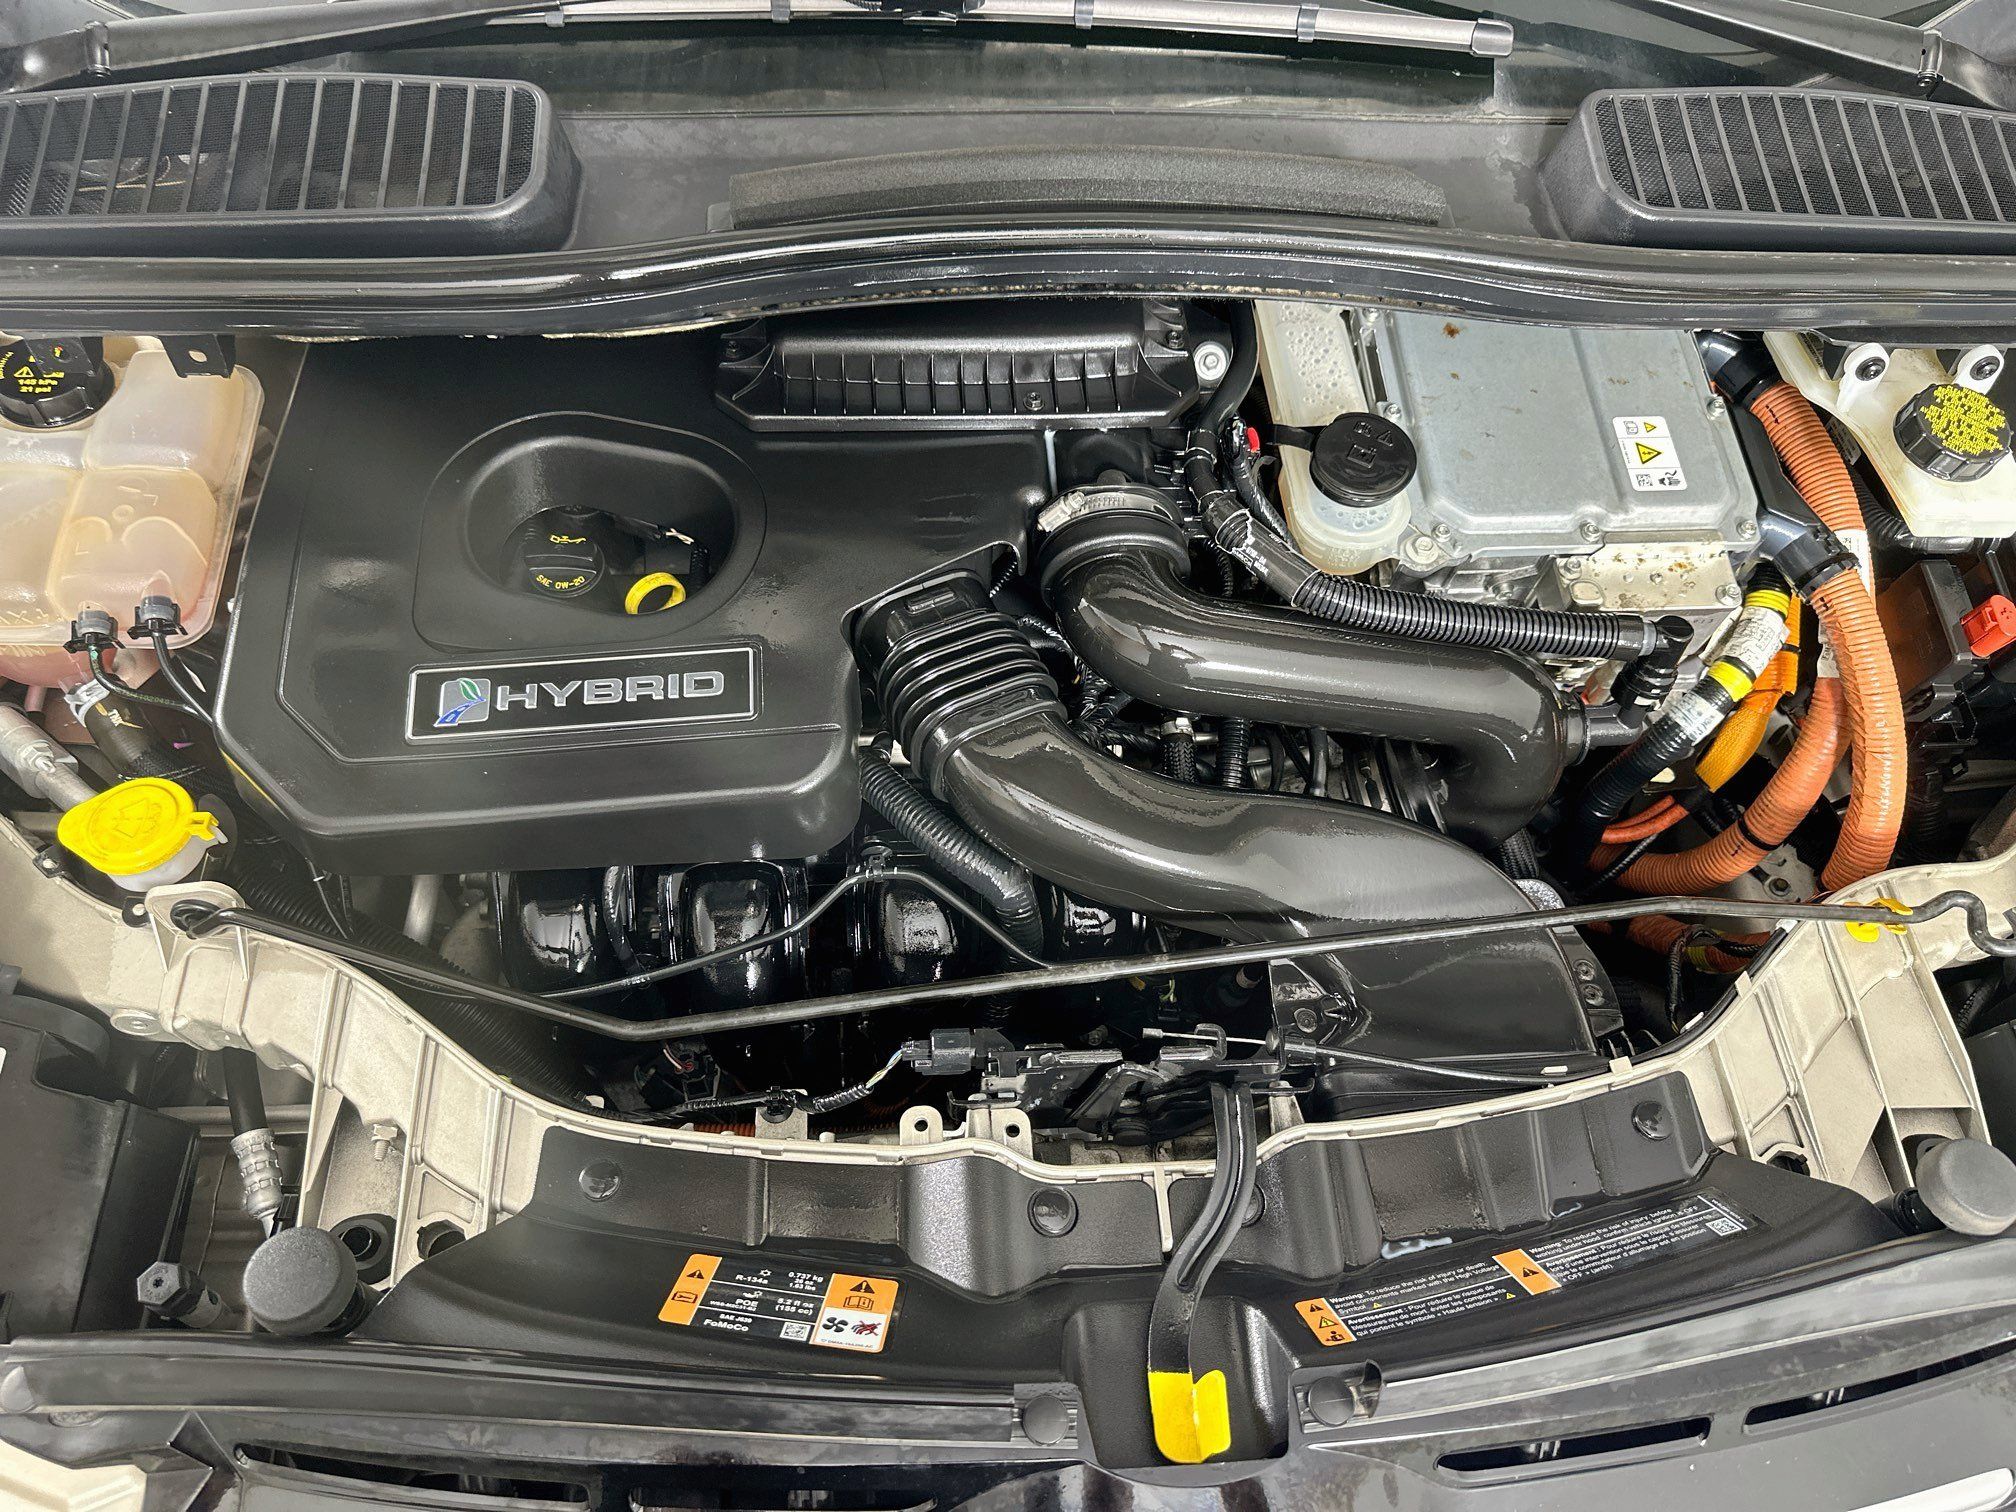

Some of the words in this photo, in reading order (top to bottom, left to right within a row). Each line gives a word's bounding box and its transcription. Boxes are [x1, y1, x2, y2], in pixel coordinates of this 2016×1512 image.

[535, 574, 552, 588] SAE
[555, 576, 586, 589] 0W-20
[496, 670, 725, 711] HYBRID
[1529, 1242, 1562, 1253] Warning:
[1573, 1232, 1596, 1241] reduce
[1649, 1209, 1672, 1217] before
[735, 1275, 768, 1284] R-134a
[1356, 1291, 1398, 1304] components
[1400, 1284, 1426, 1294] marked
[1472, 1265, 1499, 1274] Voltage
[1329, 1293, 1364, 1303] Warning:
[1376, 1285, 1400, 1293] reduce
[735, 1299, 758, 1307] POE
[704, 1319, 748, 1331] FoMoCo
